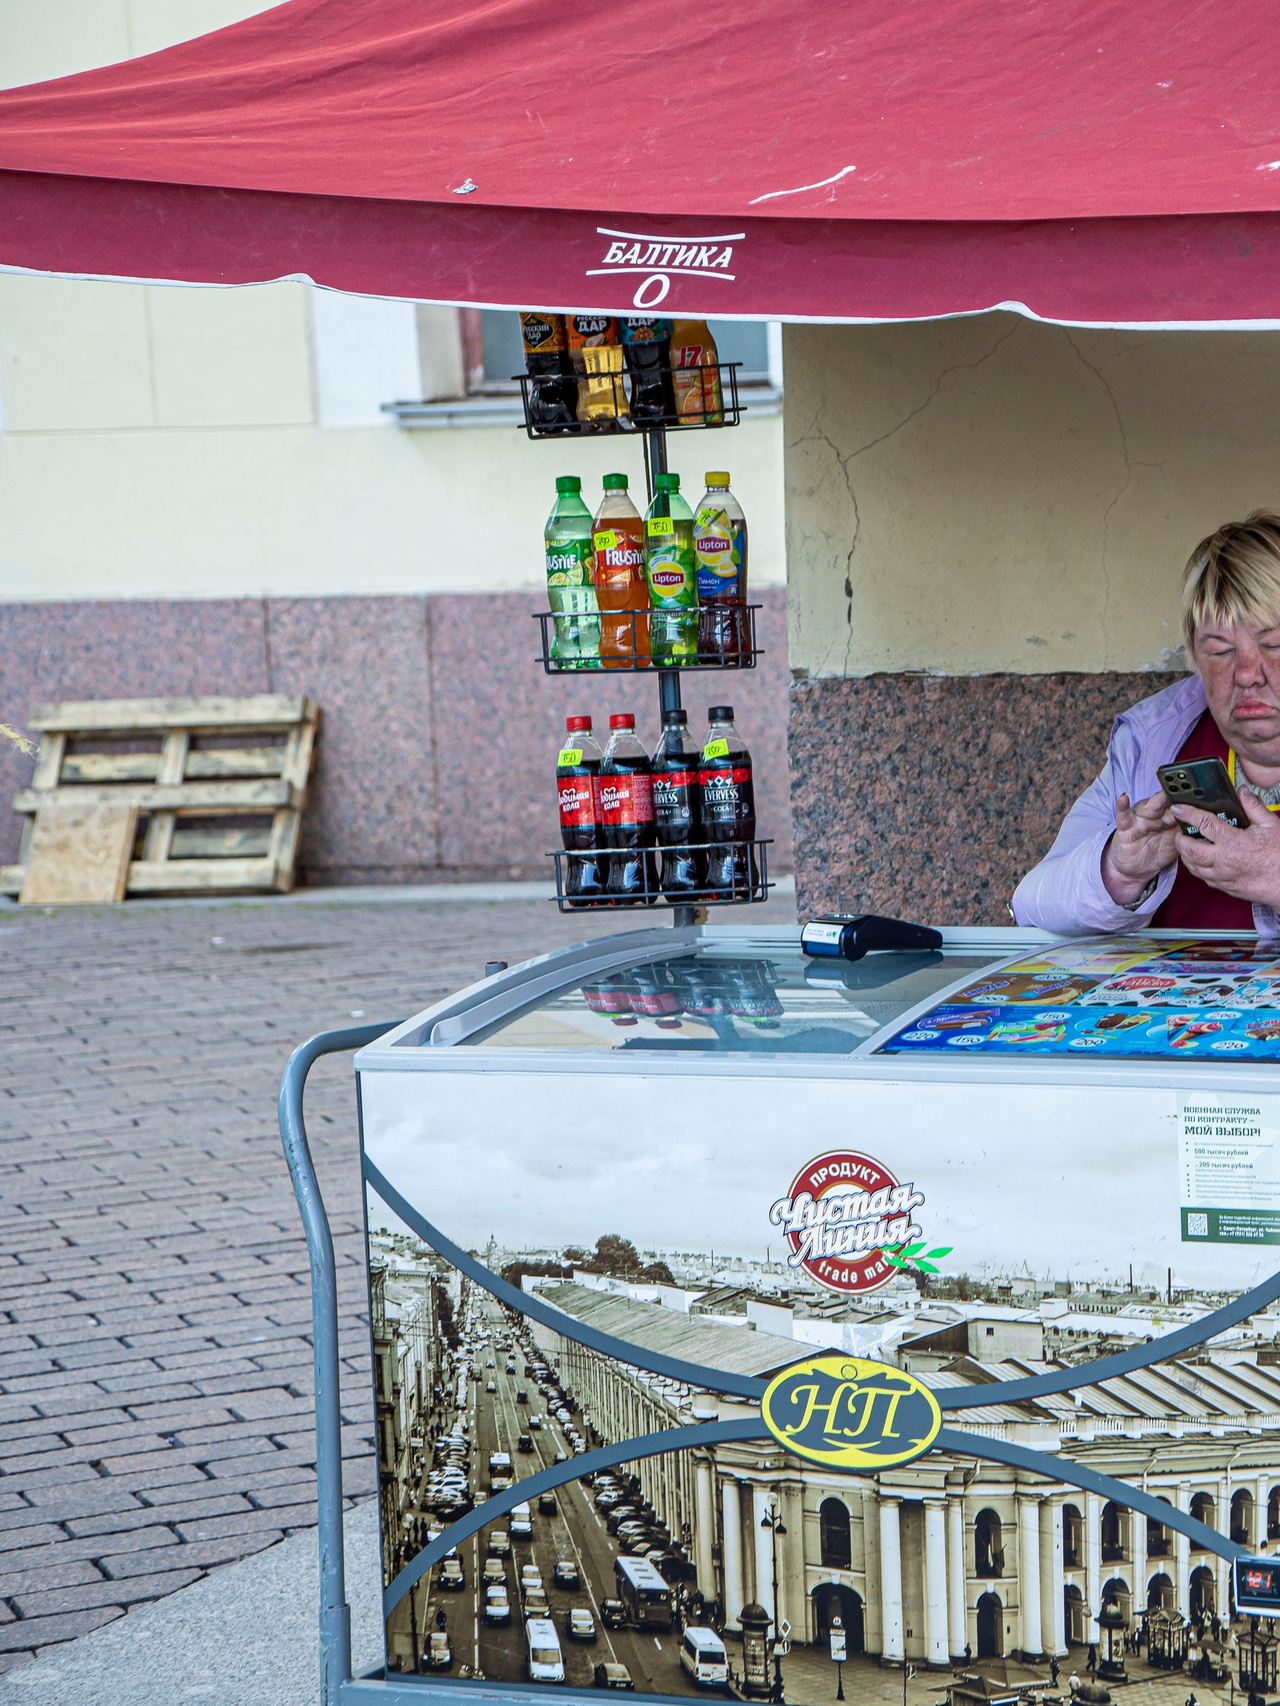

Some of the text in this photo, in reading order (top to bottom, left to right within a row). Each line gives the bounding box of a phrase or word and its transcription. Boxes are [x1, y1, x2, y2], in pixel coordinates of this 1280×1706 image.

[602, 242, 733, 268] БАЛТИКА
[578, 320, 608, 333] ДАР
[677, 345, 703, 368] J7
[698, 539, 728, 551] Lipton
[653, 574, 682, 583] Lipton
[562, 753, 576, 764] 150
[704, 788, 739, 802] EVERVESS
[563, 801, 580, 812] кола
[604, 799, 620, 811] кола
[1041, 1012, 1066, 1020] 150
[955, 1035, 980, 1044] 150
[1076, 1038, 1104, 1047] 200
[1216, 1041, 1243, 1050] 220
[1183, 1106, 1261, 1115] ВОЕННАЯ СЛУЖБА
[1184, 1115, 1248, 1124] ПО КОНТРАКТУ
[1184, 1124, 1261, 1137] МОЙ ВЫБОР!
[1226, 1148, 1249, 1157] рублей
[1231, 1161, 1254, 1170] рублей
[808, 1161, 881, 1188] ПРОДУКТ
[769, 1182, 926, 1237] Чистая
[787, 1214, 923, 1269] Линия
[818, 1259, 858, 1284] trade
[785, 1381, 917, 1438] НП
